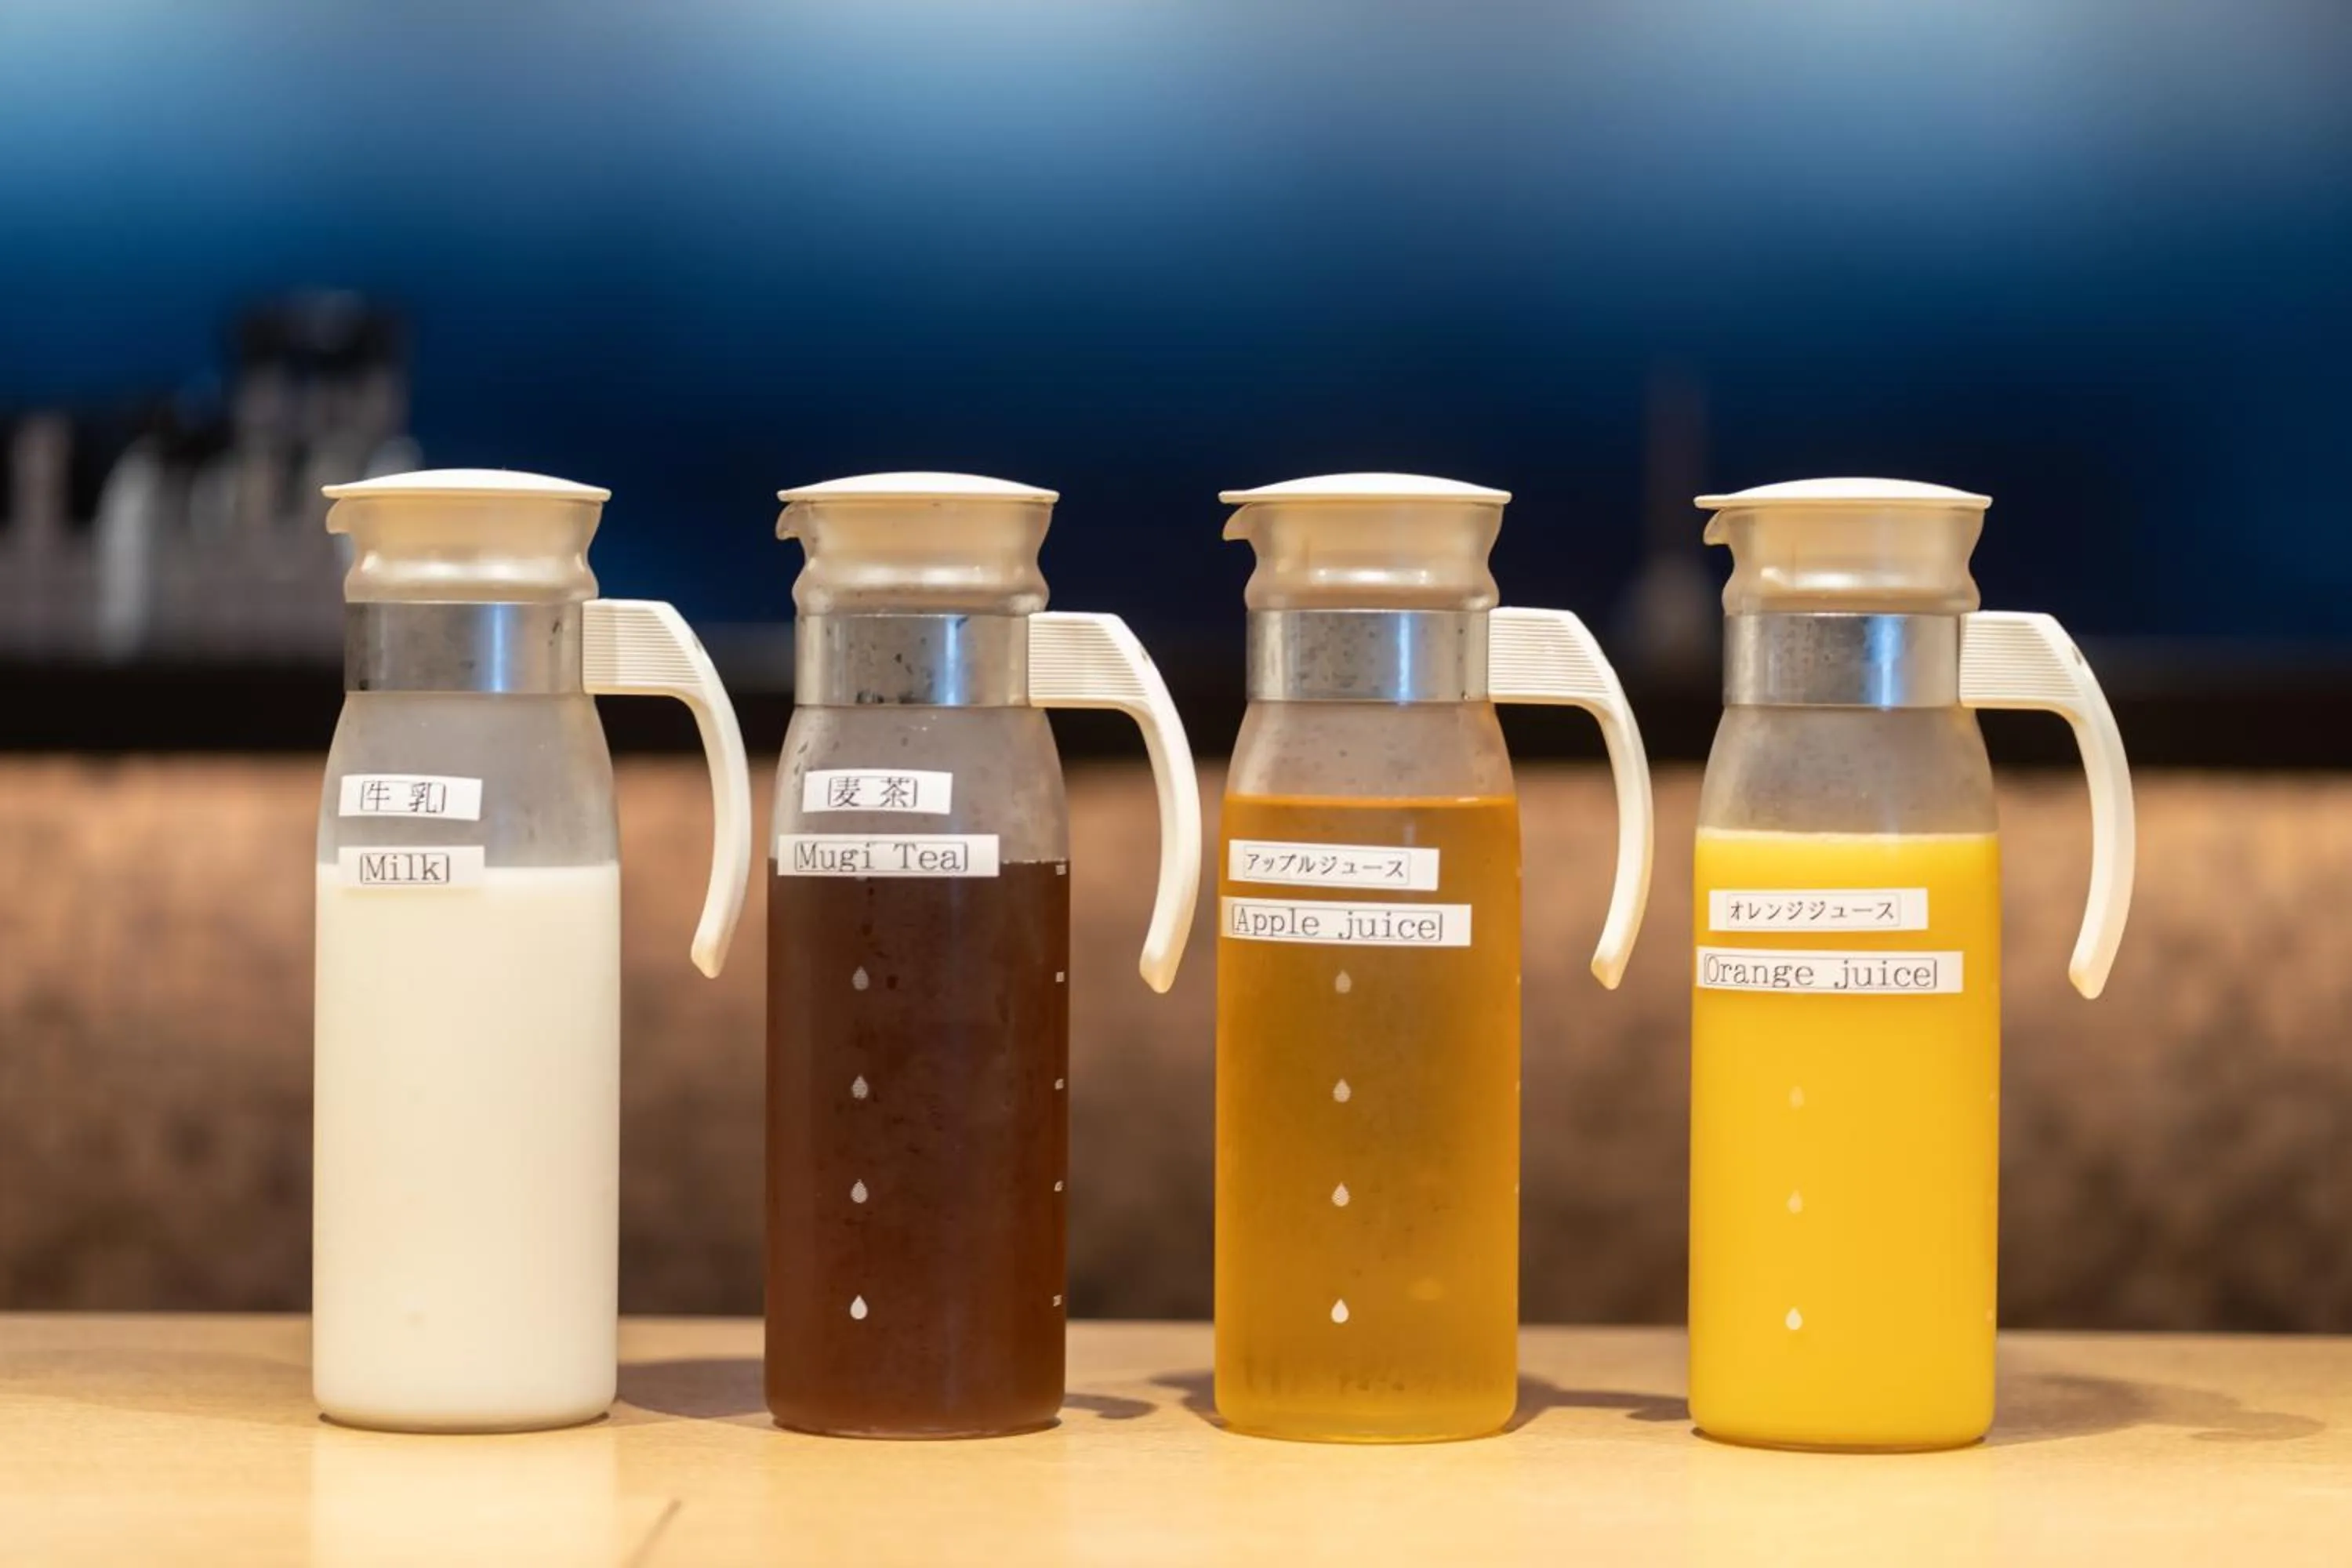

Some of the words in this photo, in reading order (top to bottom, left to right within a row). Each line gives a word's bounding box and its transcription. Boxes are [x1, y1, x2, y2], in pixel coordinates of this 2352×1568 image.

[365, 781, 438, 812] 牛乳
[832, 777, 911, 808] 麦茶
[365, 855, 441, 881] Milk
[798, 842, 875, 872] Mugi
[893, 842, 960, 869] Tea
[1246, 853, 1406, 879] アップルジュース
[1235, 908, 1320, 937] Apple
[1338, 911, 1436, 941] juice
[1730, 900, 1895, 920] オレンジジュース
[1706, 956, 1814, 989] Orange
[1833, 959, 1931, 989] juice
